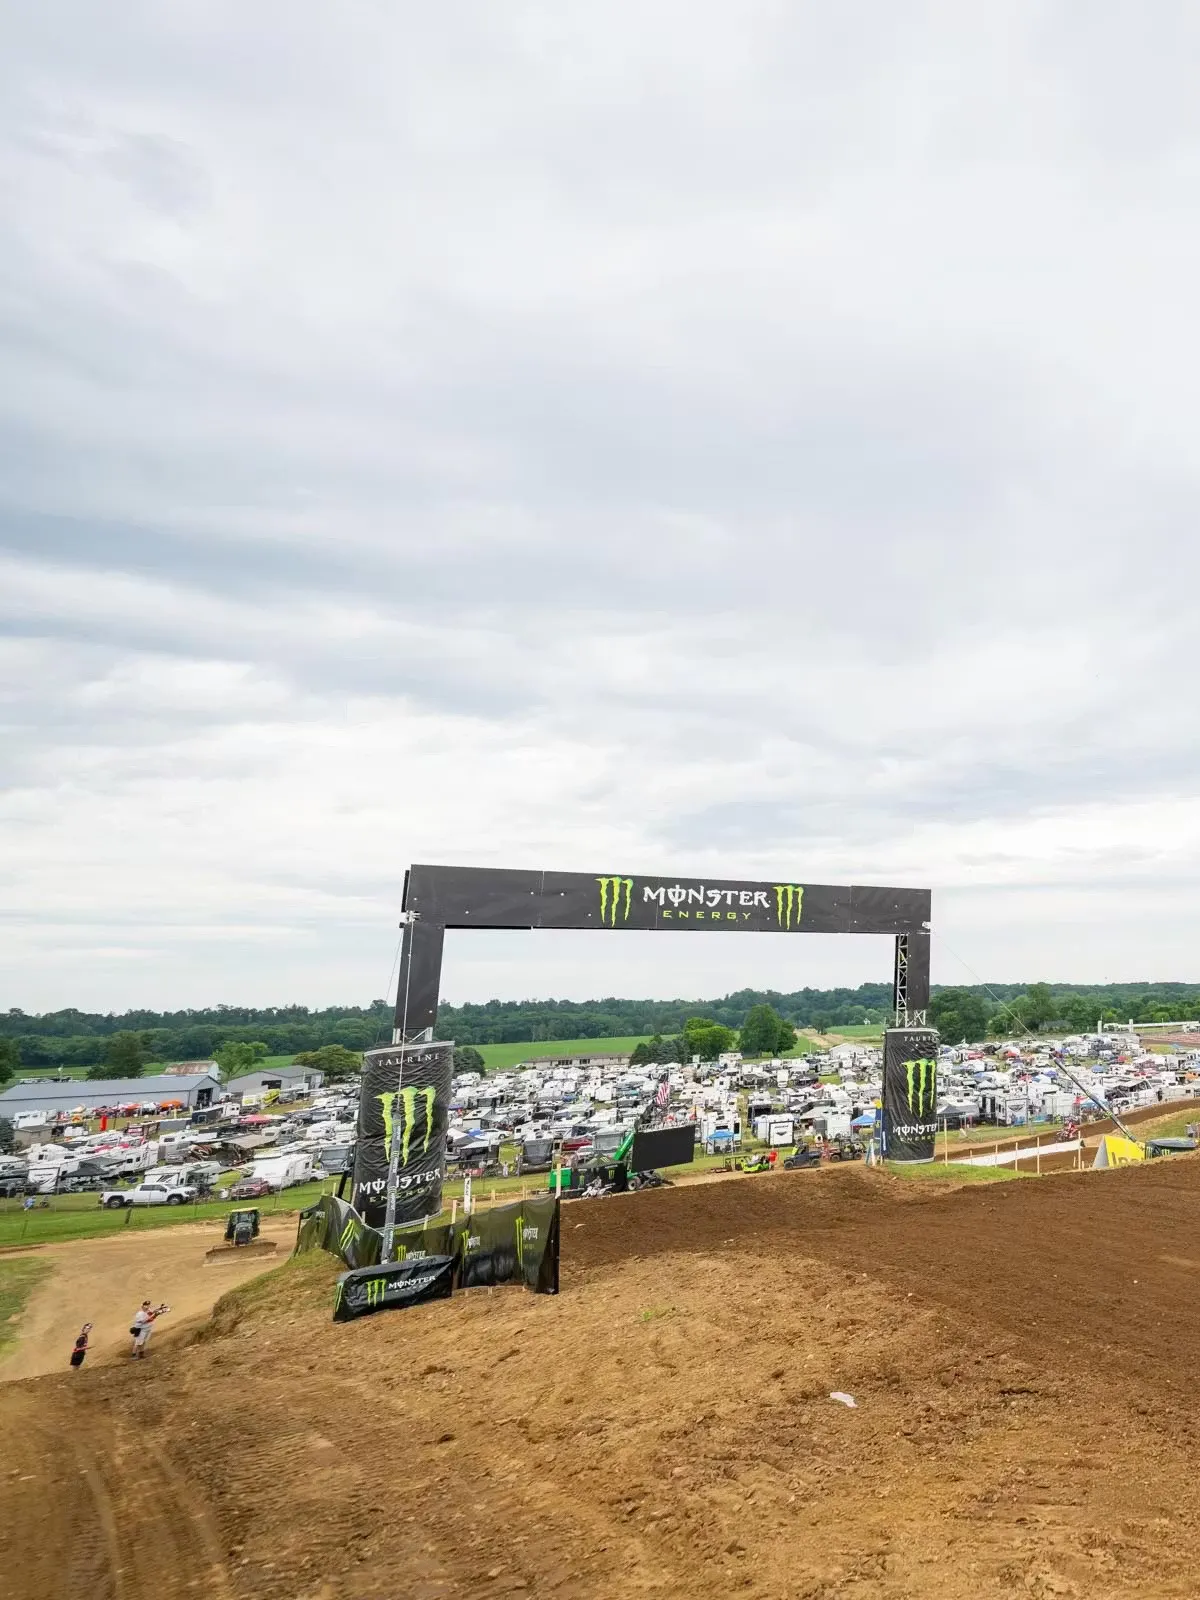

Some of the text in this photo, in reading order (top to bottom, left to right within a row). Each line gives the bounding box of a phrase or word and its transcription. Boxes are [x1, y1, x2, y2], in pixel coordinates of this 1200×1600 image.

[643, 884, 770, 908] MONSTER
[663, 910, 751, 920] ENERGY
[388, 1275, 436, 1289] MONSTER
